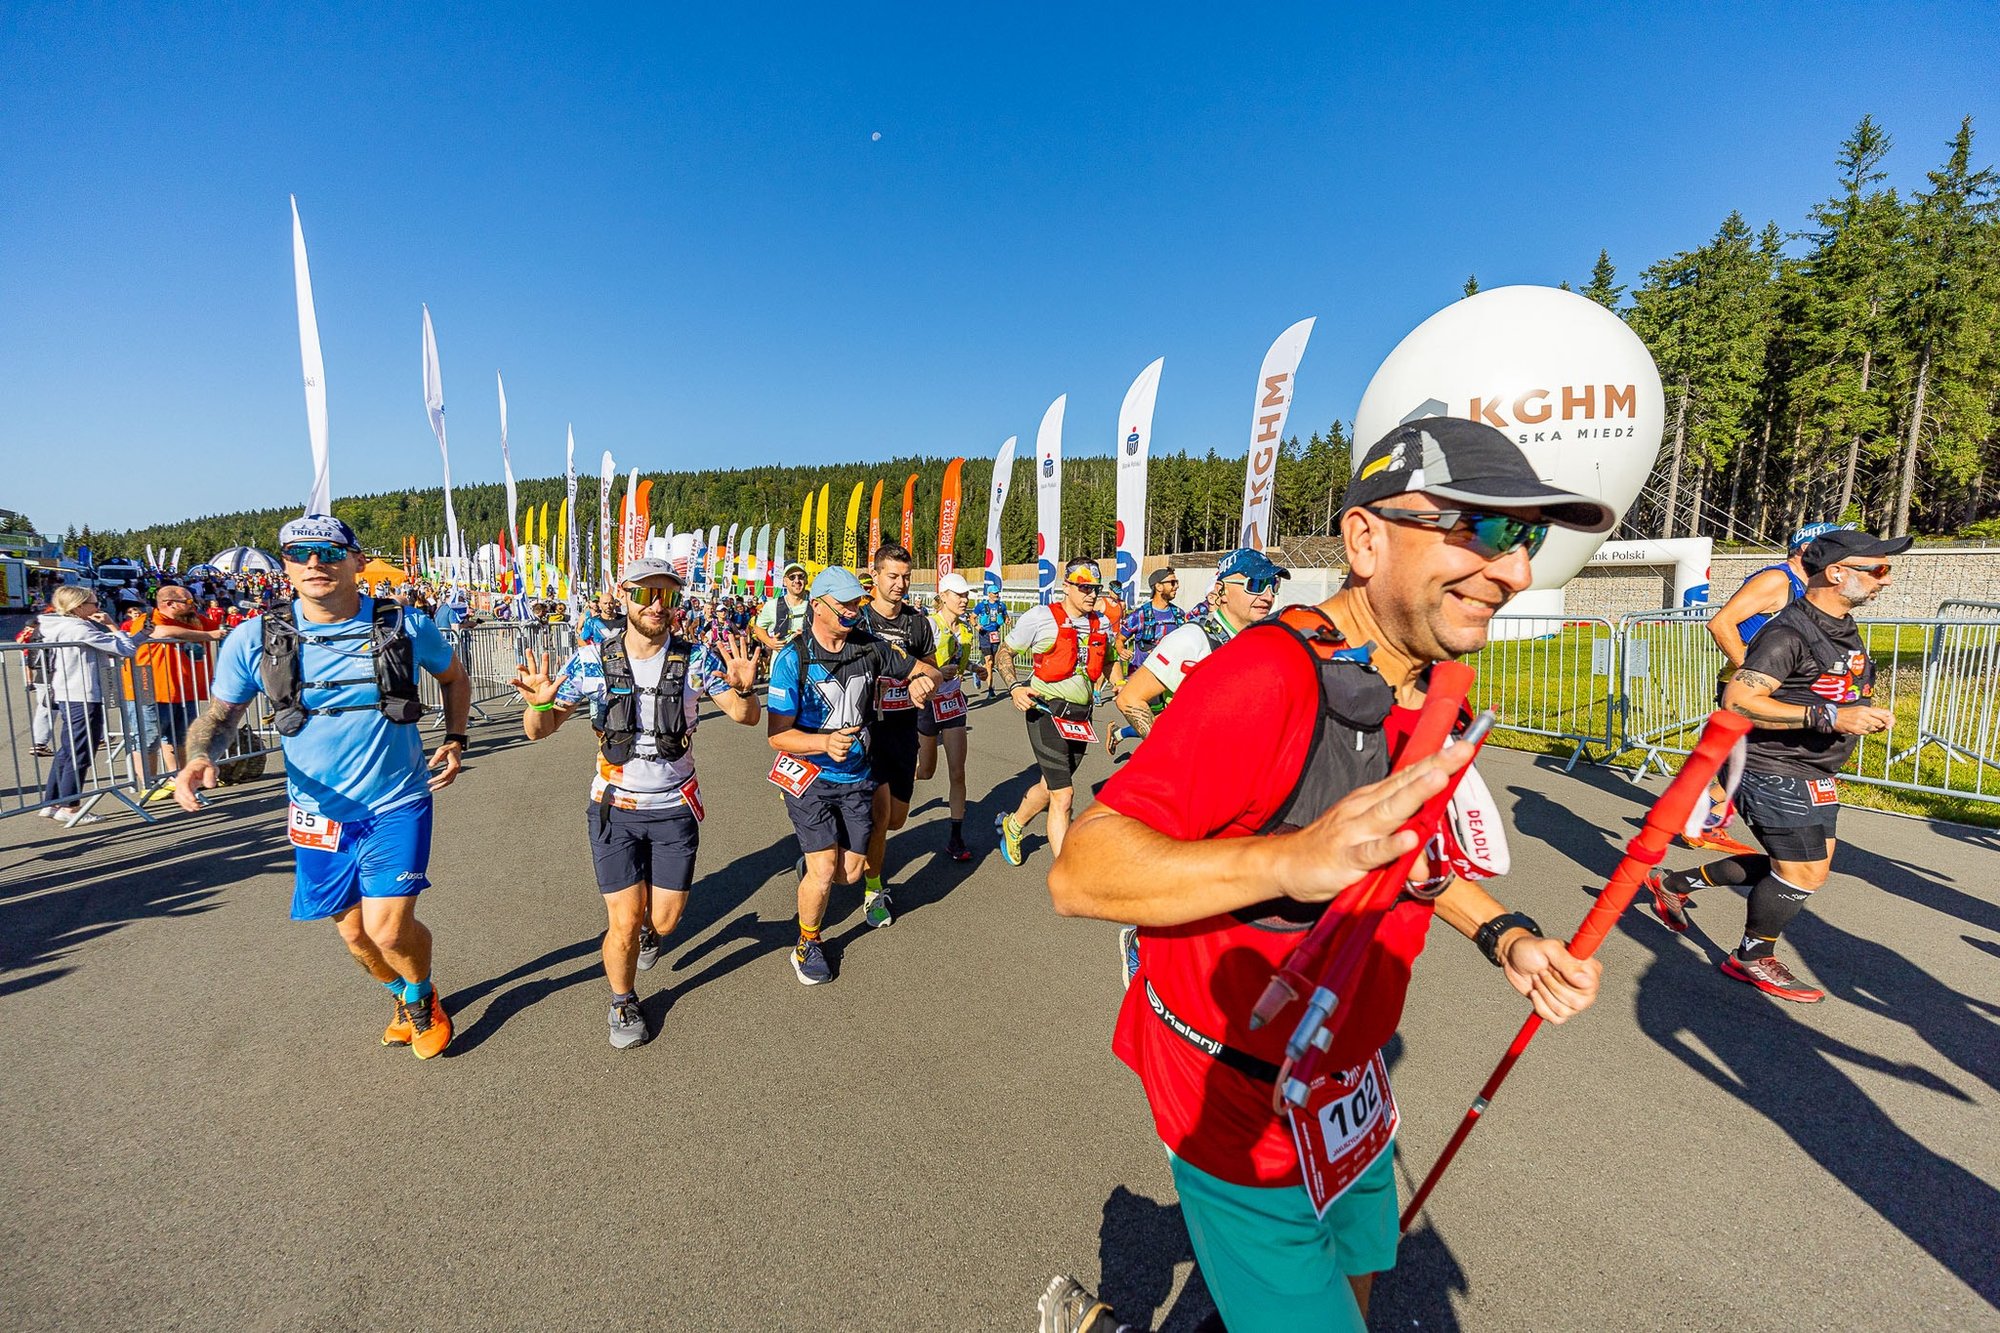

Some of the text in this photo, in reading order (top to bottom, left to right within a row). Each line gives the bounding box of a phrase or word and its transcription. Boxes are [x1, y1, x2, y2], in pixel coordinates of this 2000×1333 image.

[1470, 384, 1636, 428] KGHM
[1249, 372, 1288, 507] KGHM
[1519, 425, 1634, 444] SKA MIEDŹ
[291, 529, 332, 537] TRIGAR
[1592, 550, 1645, 560] nk Polski
[779, 757, 804, 775] 217
[296, 810, 316, 827] 65
[1467, 810, 1491, 861] DEADLY
[1164, 1010, 1223, 1055] Kalenji
[1328, 1070, 1378, 1139] 102
